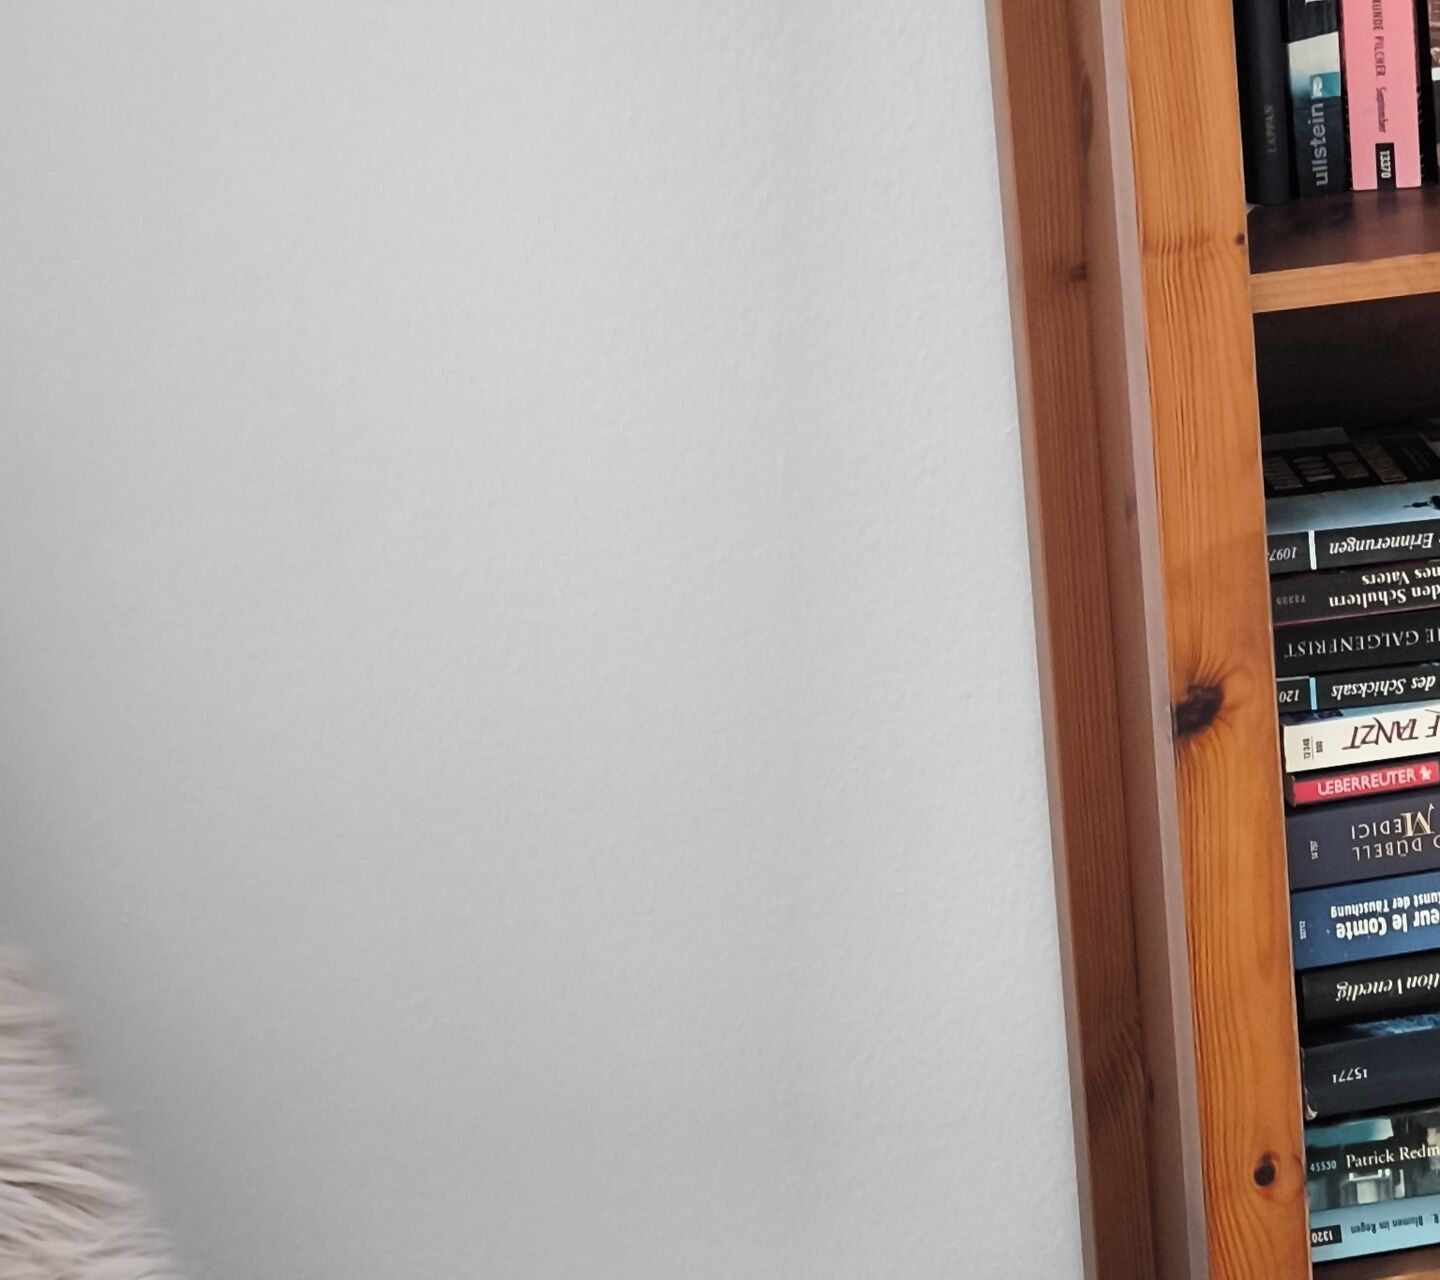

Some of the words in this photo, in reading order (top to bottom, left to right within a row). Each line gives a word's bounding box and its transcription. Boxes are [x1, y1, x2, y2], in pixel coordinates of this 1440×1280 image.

[1373, 36, 1386, 77] PILCHER
[1308, 103, 1329, 186] ullstein
[1329, 532, 1434, 555] Erinnerungen
[1361, 569, 1411, 586] Vaters
[1328, 588, 1407, 608] Schultern
[1284, 629, 1420, 658] GALGENFRIST
[1331, 678, 1406, 700] Schicksals
[1411, 676, 1437, 691] des
[1341, 717, 1419, 751] TANZT
[1317, 768, 1417, 796] UEBERREUTER
[1351, 803, 1436, 839] MEDICI
[1352, 836, 1423, 862] DÜBELL
[1330, 898, 1390, 919] Täuschung
[1393, 895, 1410, 909] der
[1335, 919, 1387, 940] Comte
[1392, 914, 1408, 933] le
[1335, 978, 1404, 1002] Venedig
[1332, 1067, 1368, 1084] 15771
[1345, 1148, 1396, 1170] Patrick
